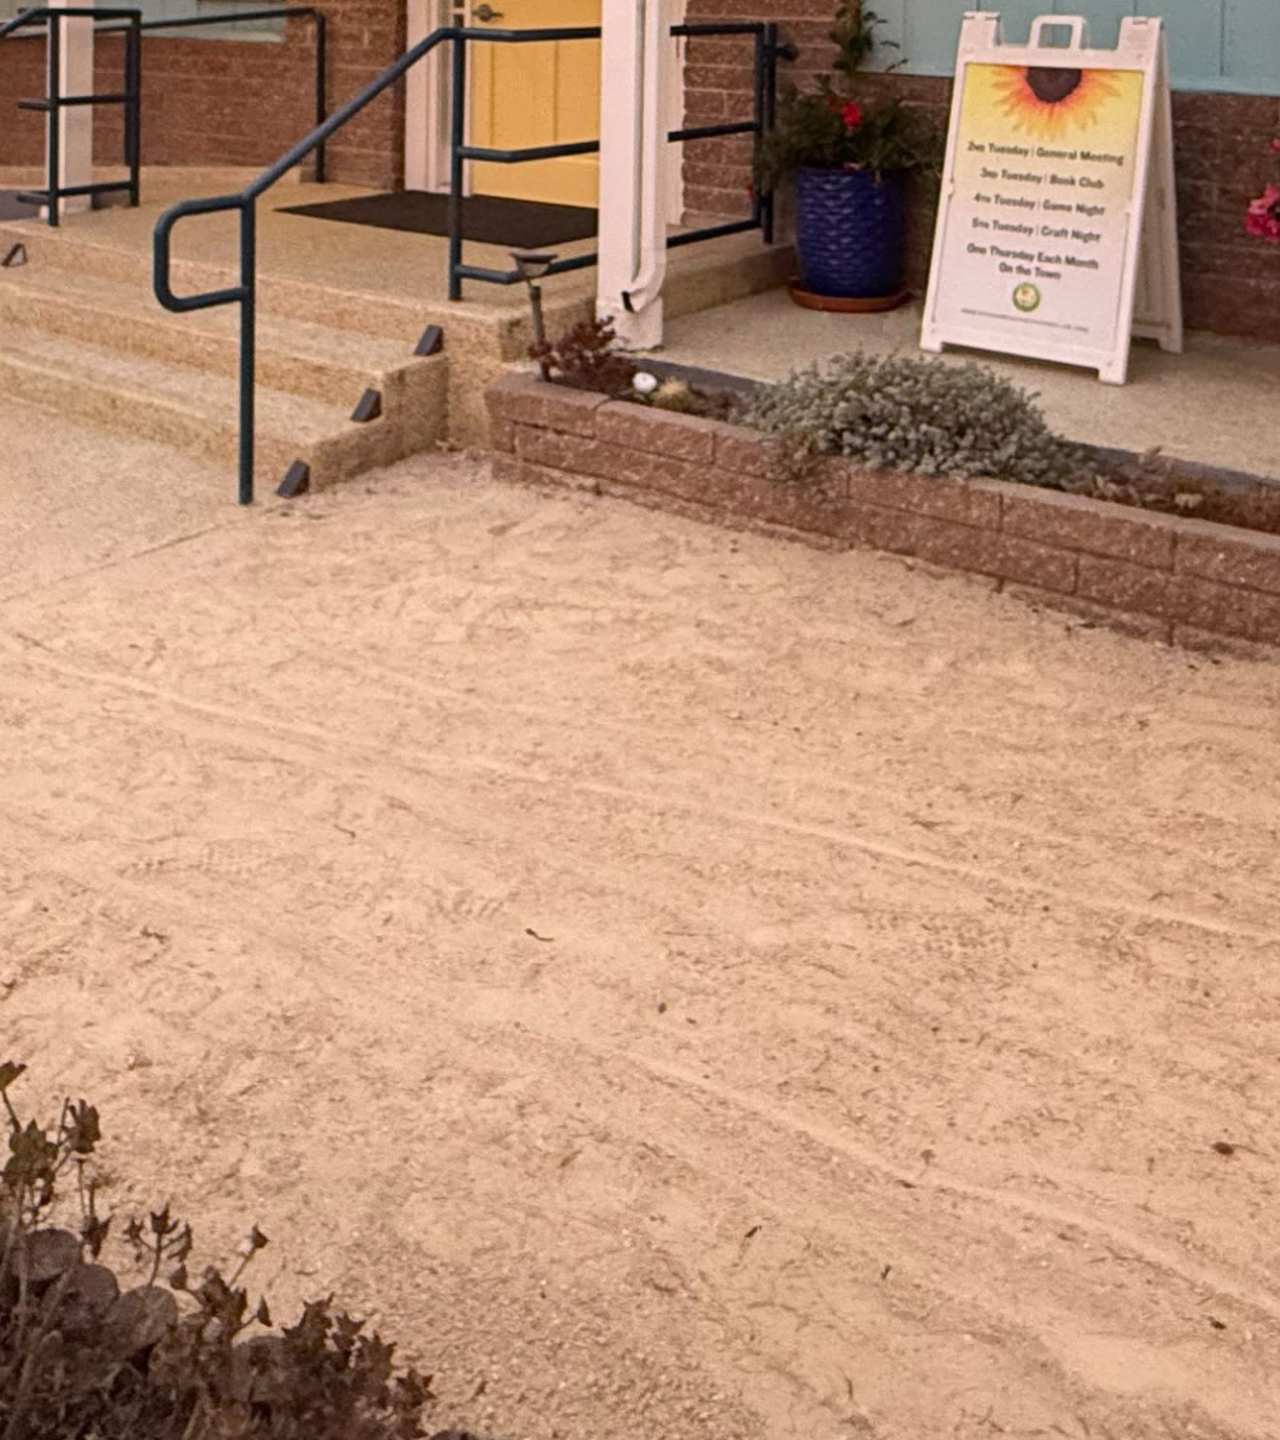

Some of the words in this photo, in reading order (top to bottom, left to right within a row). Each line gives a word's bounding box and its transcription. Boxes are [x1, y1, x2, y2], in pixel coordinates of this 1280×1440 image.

[989, 143, 1029, 157] Tuesday
[1036, 147, 1077, 160] General
[1080, 151, 1124, 166] Meeting
[1001, 168, 1042, 184] Tuesday
[1050, 174, 1076, 186] Book
[1079, 176, 1104, 189] Club
[994, 194, 1035, 210] Tuesday
[1043, 199, 1072, 212] Game
[1075, 203, 1105, 217] Night
[993, 219, 1034, 237] Tuesday
[1041, 225, 1068, 238] Craft
[1071, 230, 1101, 243] Night
[967, 243, 987, 255] One
[990, 245, 1035, 262] Thursday
[1037, 252, 1062, 264] Each
[1065, 255, 1099, 270] Month
[999, 261, 1013, 273] On
[1016, 265, 1032, 276] the
[1035, 266, 1061, 279] Town
